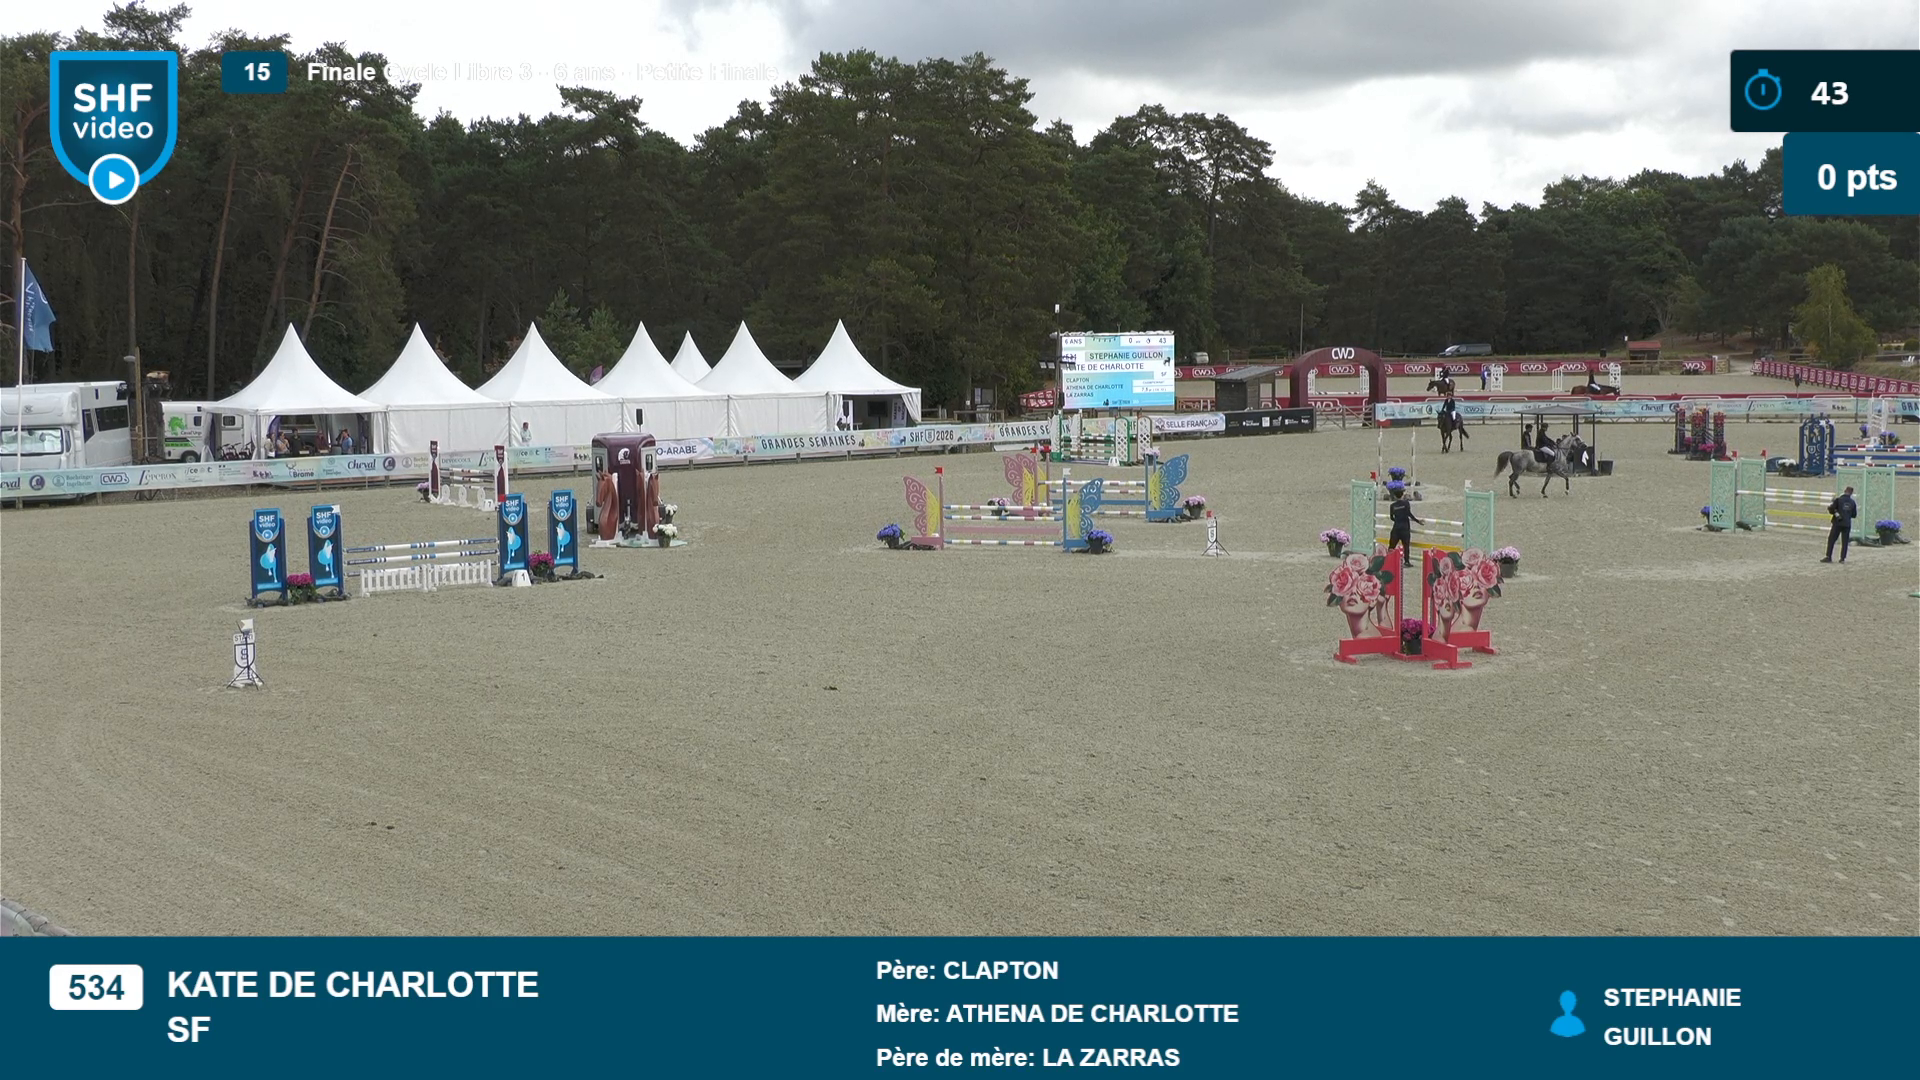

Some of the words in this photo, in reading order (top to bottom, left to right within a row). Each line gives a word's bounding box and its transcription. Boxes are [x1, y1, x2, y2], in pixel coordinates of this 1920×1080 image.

[1089, 352, 1130, 360] STEPHANIE
[1131, 351, 1163, 359] GUILLON
[1331, 347, 1355, 360] CWD
[1087, 363, 1098, 371] DE
[1099, 362, 1145, 370] CHARLOTTE
[1166, 420, 1186, 429] SELLE
[1187, 418, 1218, 428] FRANÇAIS
[1000, 424, 1037, 437] GRANDES
[761, 437, 805, 450] GRANDES
[808, 434, 856, 448] SEMAINES
[909, 431, 923, 442] SHF
[656, 445, 697, 456] O-ARABE
[347, 459, 376, 470] Cheval
[555, 495, 569, 503] SHF
[258, 514, 276, 522] SHF
[316, 511, 332, 519] SHF
